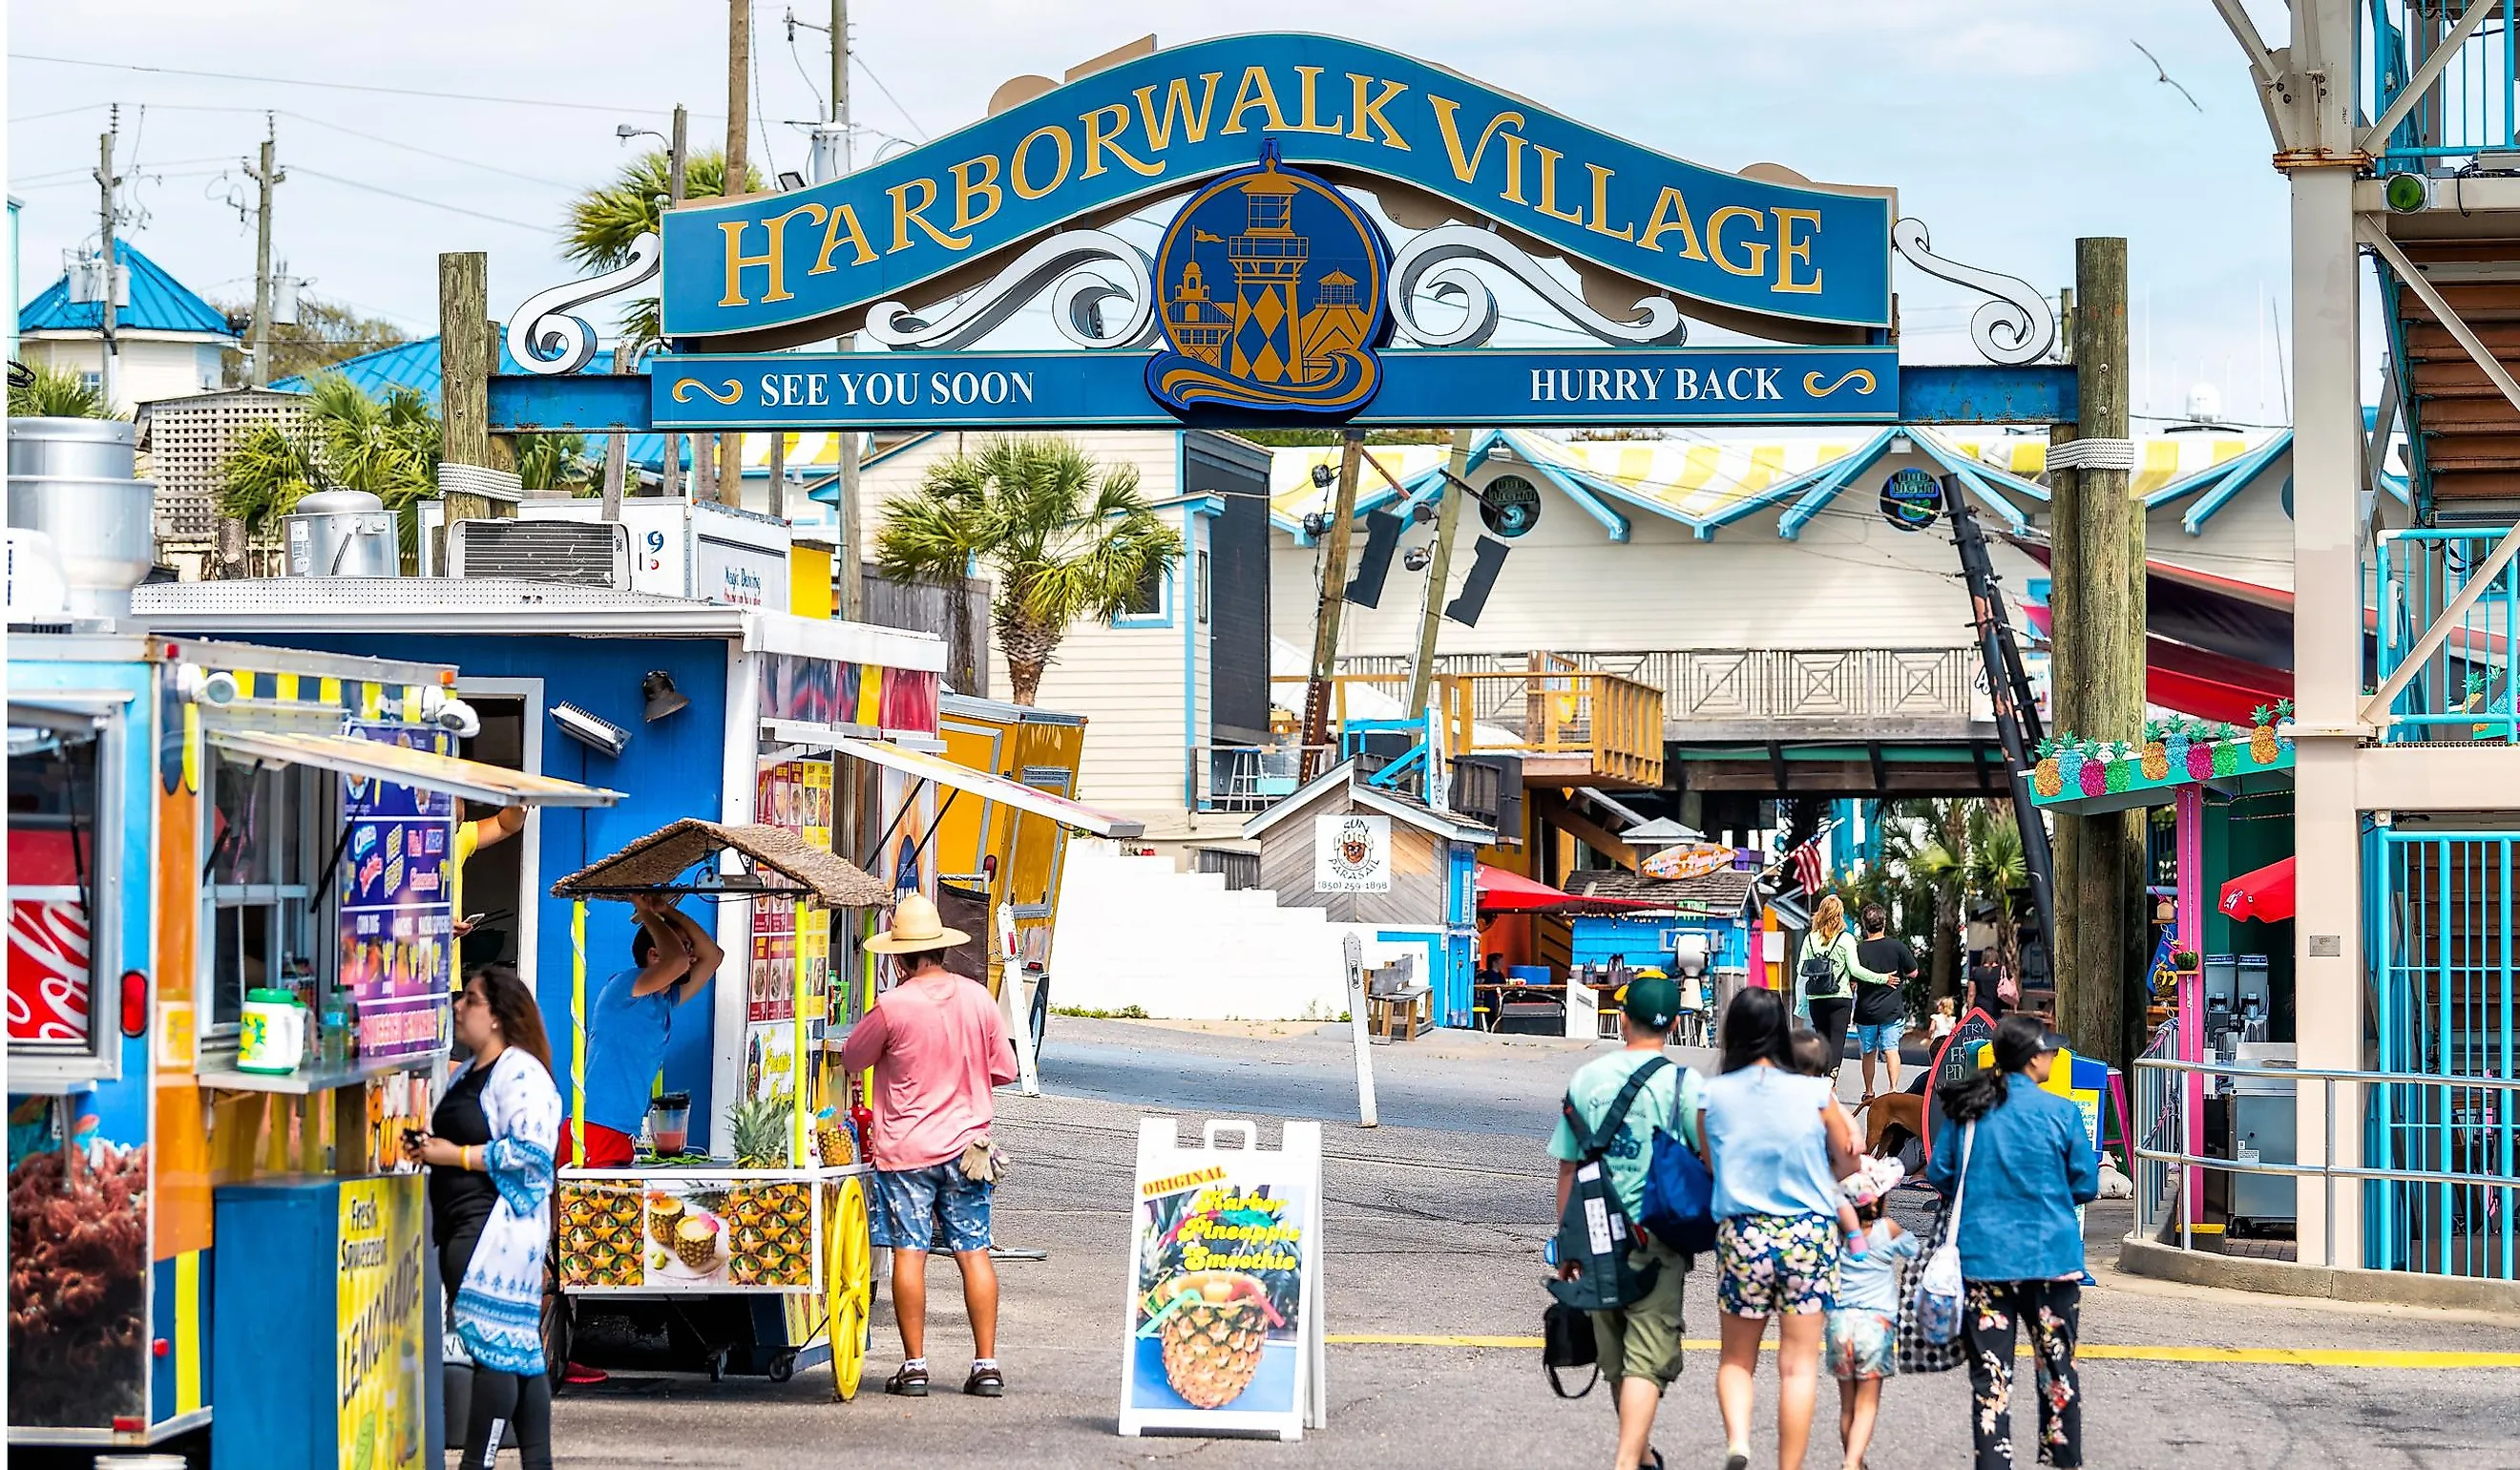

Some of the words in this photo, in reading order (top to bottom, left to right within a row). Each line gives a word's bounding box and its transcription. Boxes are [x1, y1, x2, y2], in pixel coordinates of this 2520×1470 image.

[717, 64, 1412, 307] HARBORWALK
[1427, 93, 1824, 295] VILLAGE
[761, 373, 830, 407] SEE
[838, 372, 919, 406] YOU
[931, 371, 1034, 405] SOON
[1530, 368, 1666, 401] HURRY
[1674, 368, 1784, 401] BACK
[1333, 830, 1375, 851] DOGS
[1343, 818, 1371, 834] SUN
[1327, 858, 1380, 880] PARASAIL
[1964, 1022, 1986, 1035] TRY
[1142, 1166, 1227, 1196] ORIGINAL
[350, 1190, 378, 1231] Fresh
[1193, 1186, 1289, 1214] Harbor
[1176, 1213, 1301, 1246] Pineapple
[340, 1228, 388, 1282] Squeezed
[1182, 1244, 1297, 1272] Smoothie
[342, 1234, 421, 1410] LEMONADE
